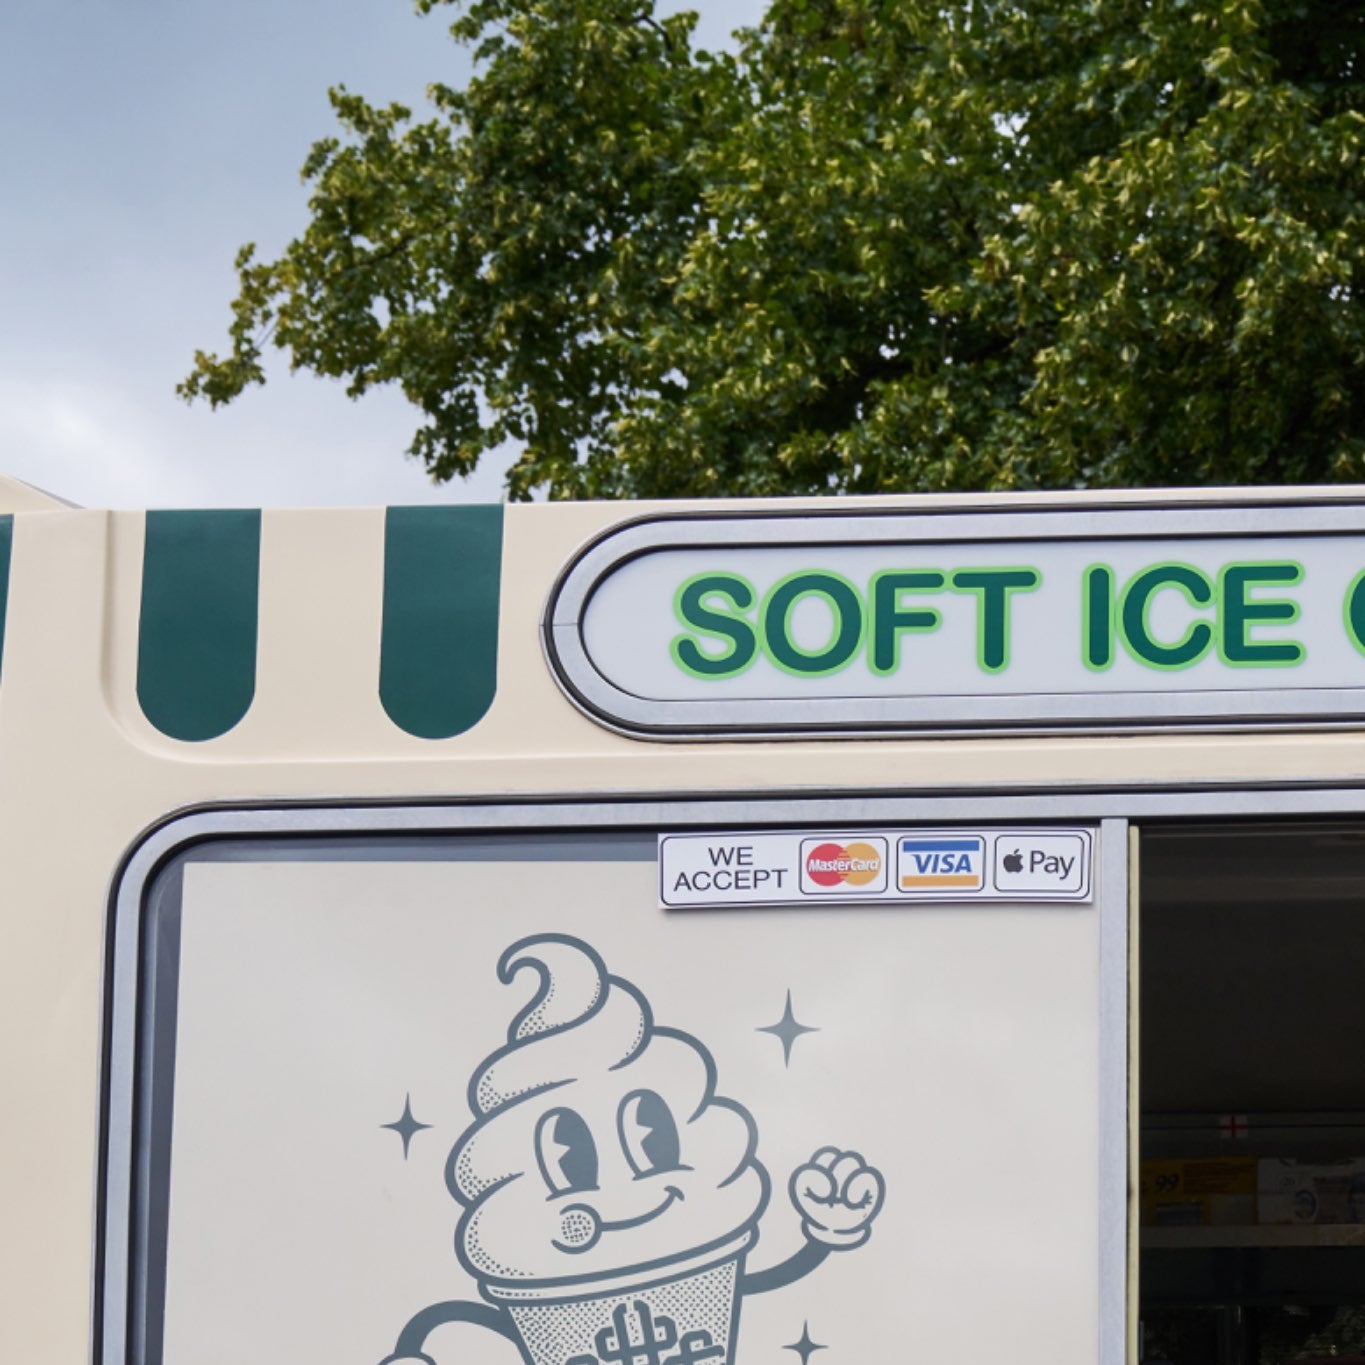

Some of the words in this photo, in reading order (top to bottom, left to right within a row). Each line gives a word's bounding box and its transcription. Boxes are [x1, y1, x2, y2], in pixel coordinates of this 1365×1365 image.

[671, 565, 1043, 679] SOFT
[1081, 560, 1306, 672] ICE
[708, 846, 753, 867] WE
[807, 857, 879, 873] MasterCard
[912, 853, 972, 874] VISA
[1029, 850, 1075, 880] Pay
[673, 869, 788, 892] ACCEPT
